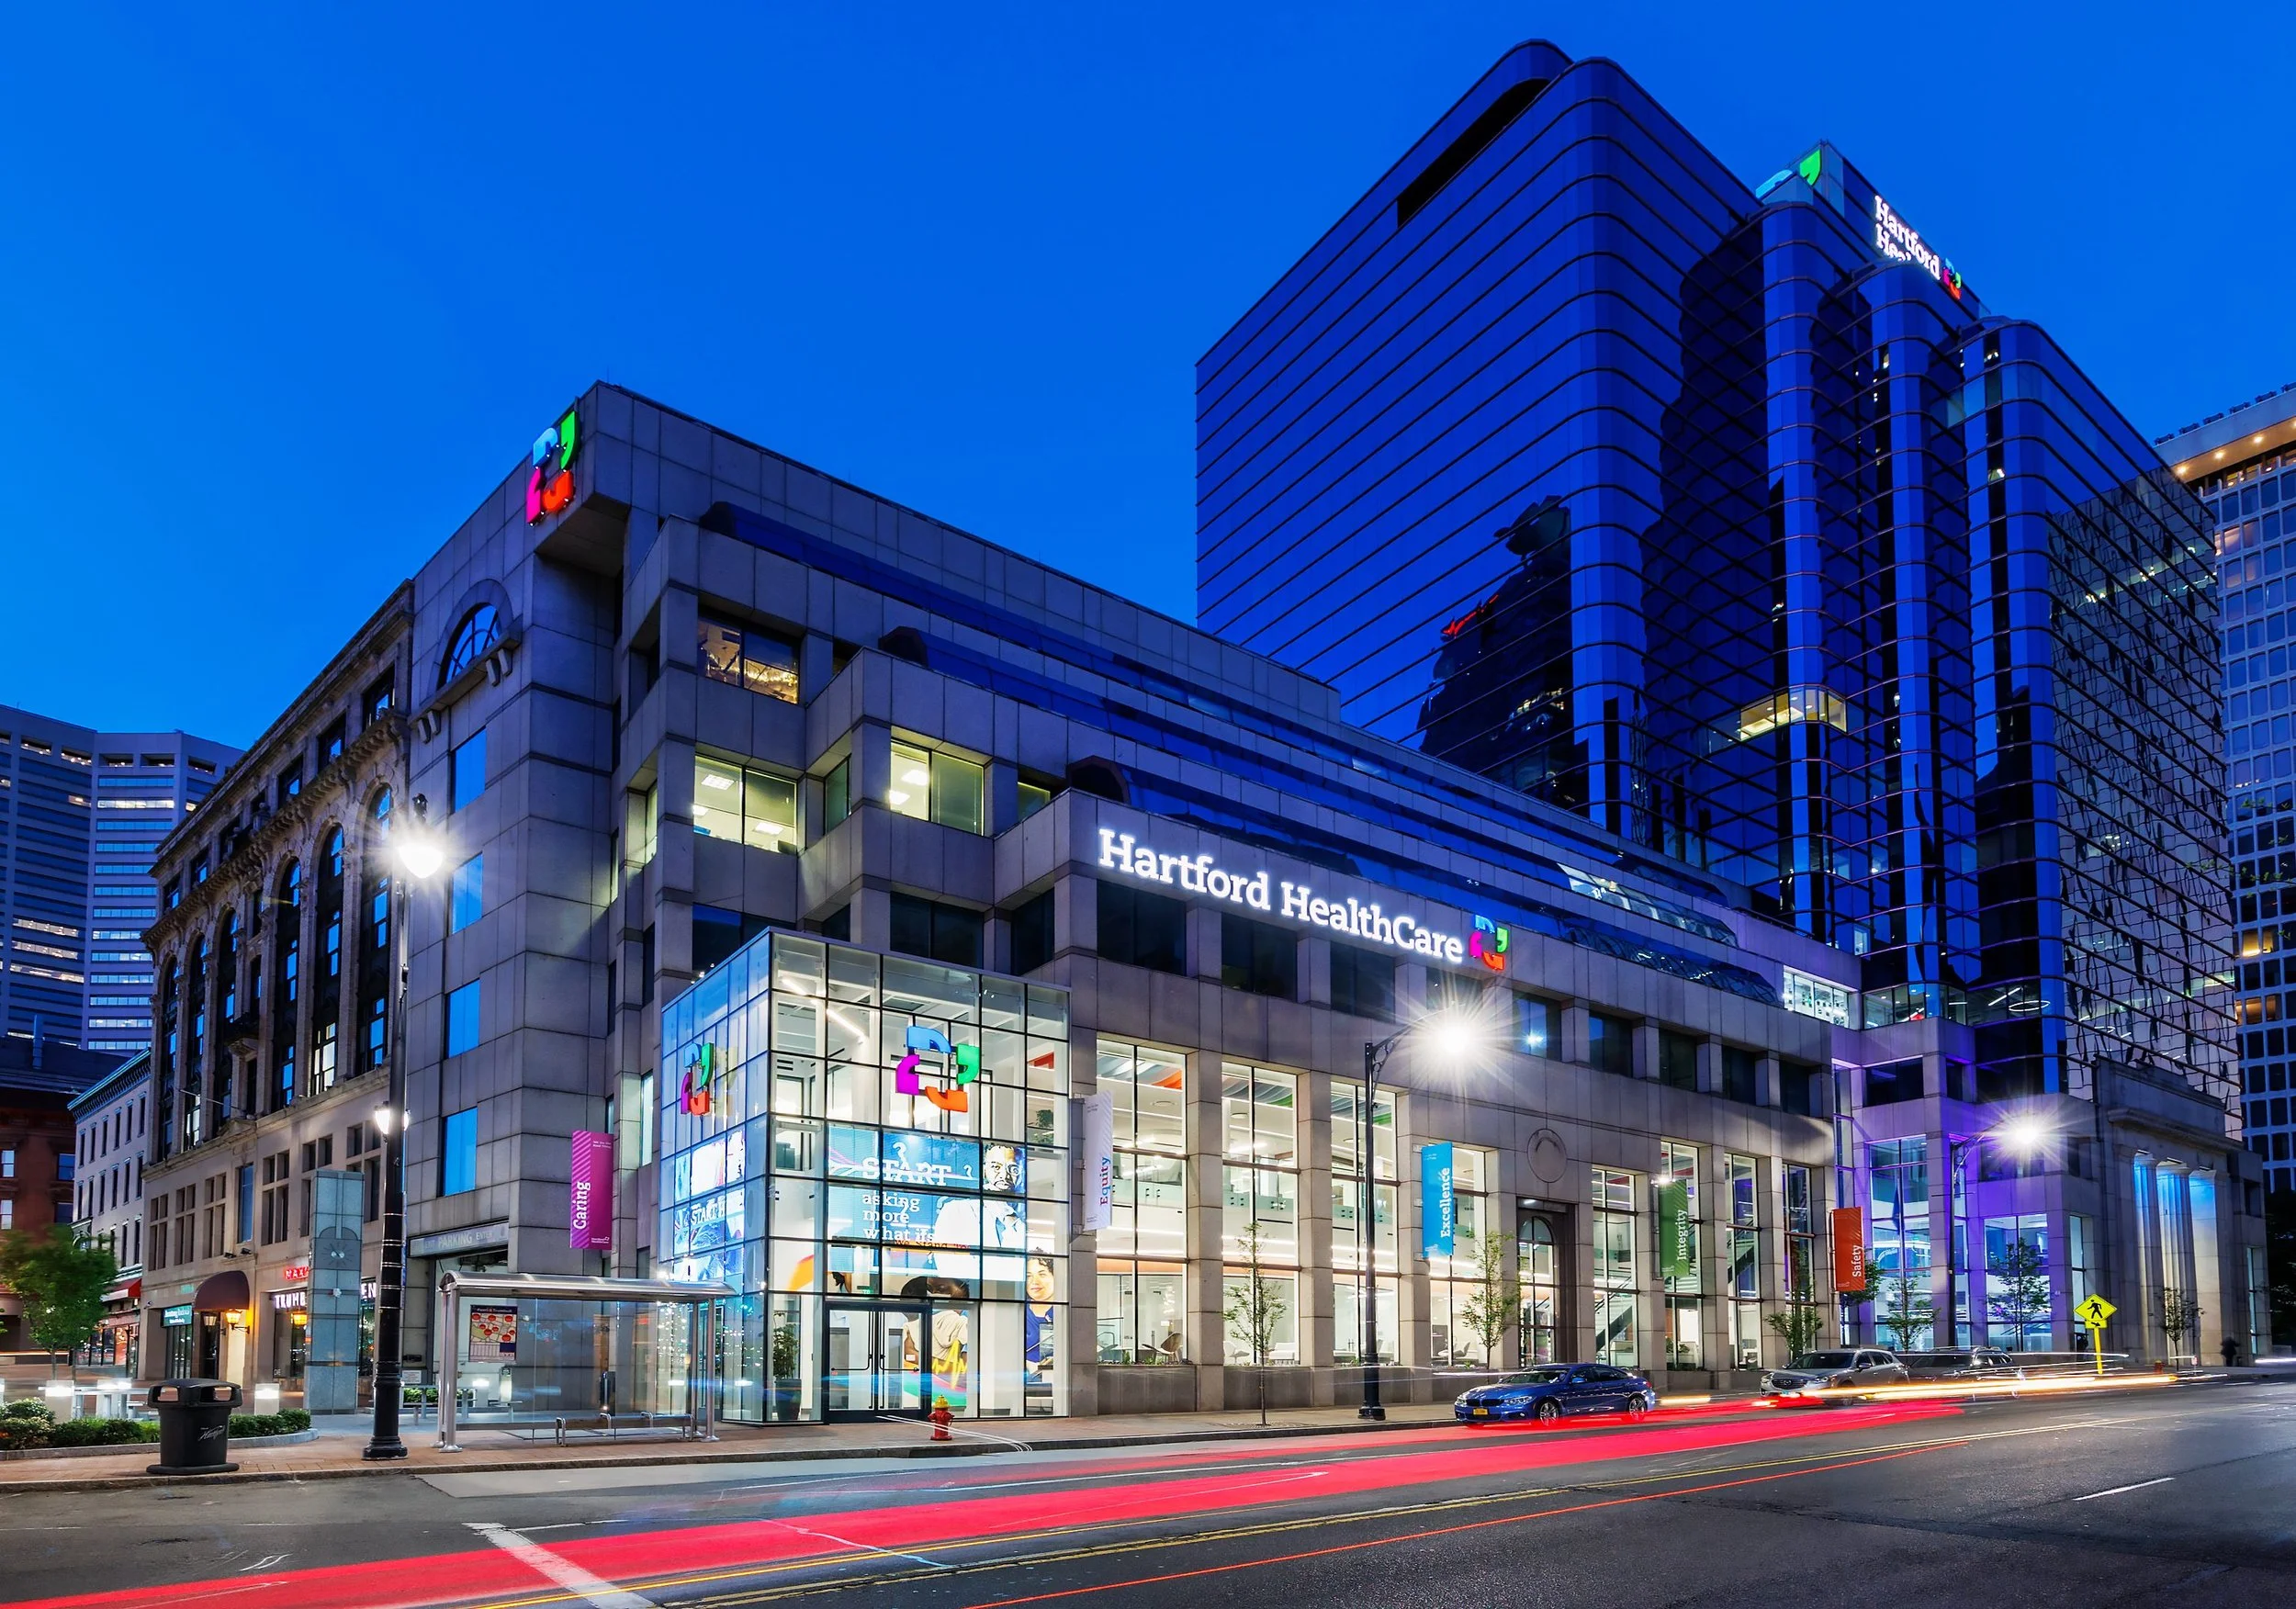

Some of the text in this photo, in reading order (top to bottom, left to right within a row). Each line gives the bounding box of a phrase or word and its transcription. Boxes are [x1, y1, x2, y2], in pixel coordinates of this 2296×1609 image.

[1874, 195, 1941, 280] Hartford
[1098, 828, 1463, 963] Hartford HealthCare
[861, 1156, 951, 1187] START
[1099, 1156, 1111, 1206] Equity
[572, 1181, 591, 1230] Caring
[862, 1191, 921, 1212] asking
[863, 1210, 910, 1224] more
[1439, 1167, 1452, 1238] Excellence
[438, 1232, 472, 1248] PARKING
[863, 1226, 911, 1241] what
[1675, 1210, 1689, 1261] Integrity
[1851, 1245, 1864, 1277] Safety
[275, 1291, 306, 1310] TRUMB
